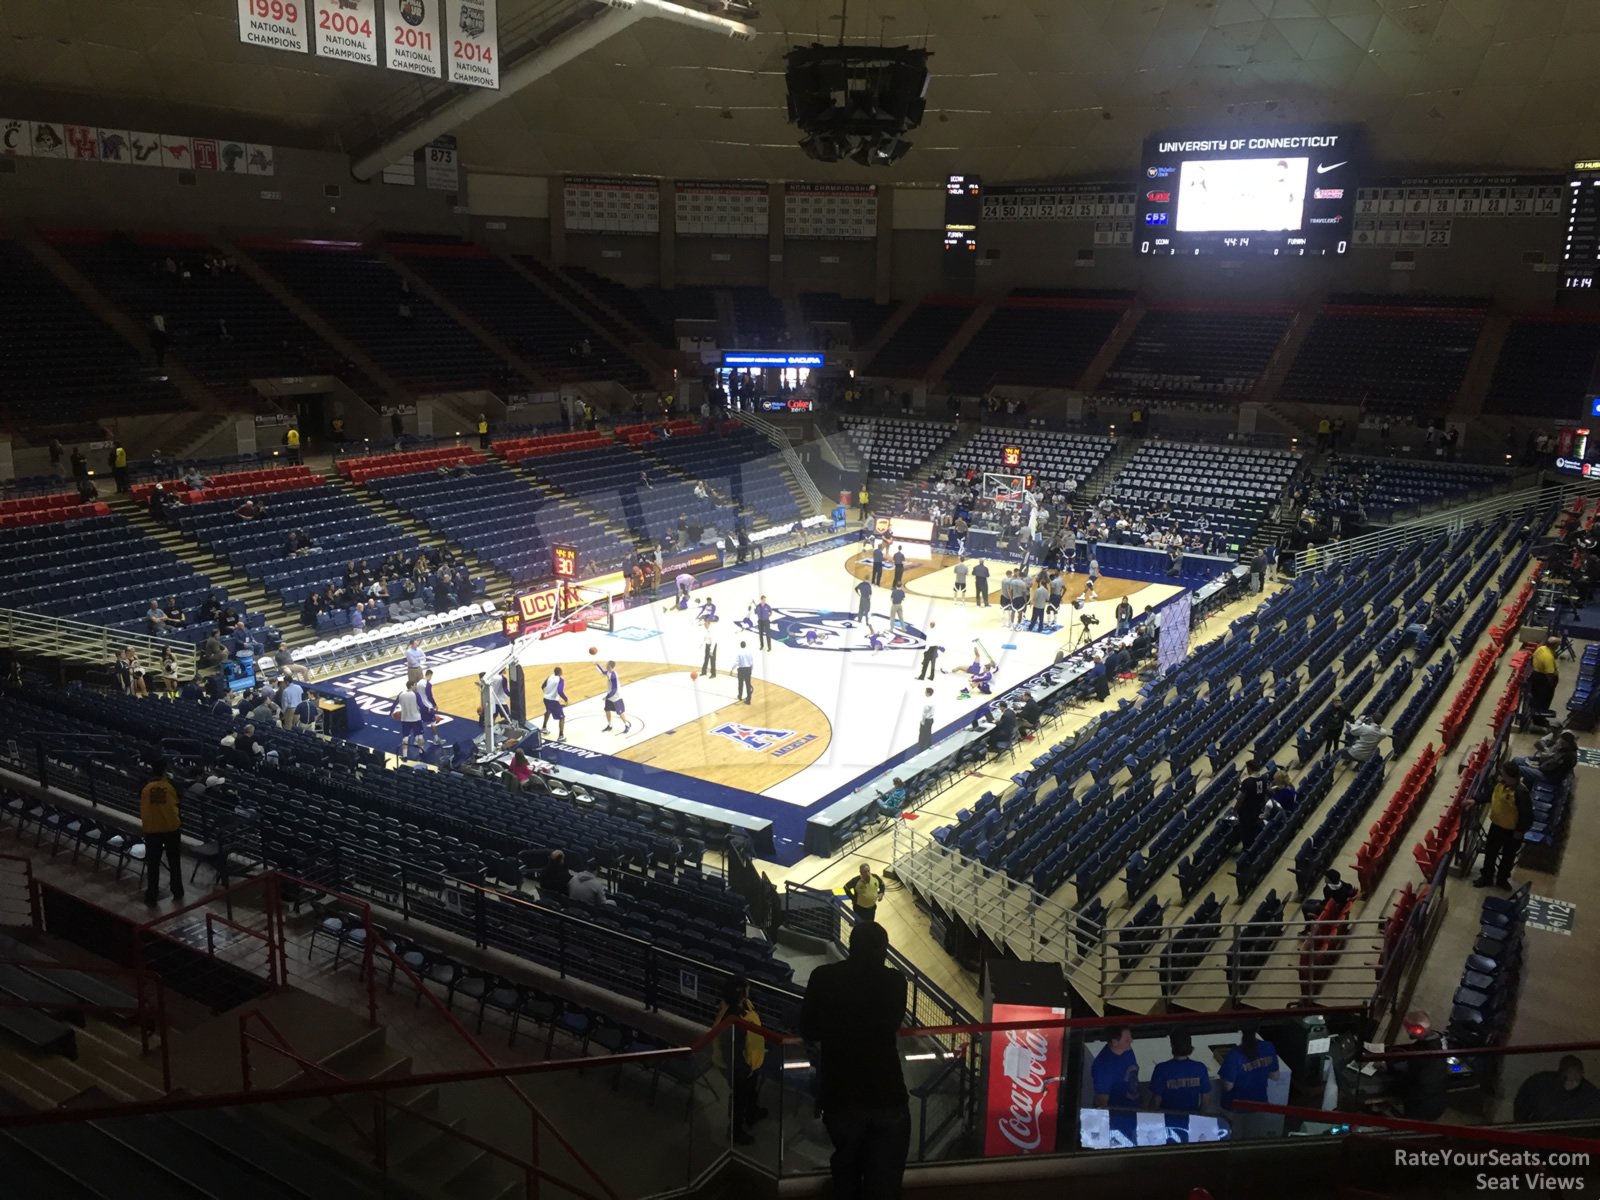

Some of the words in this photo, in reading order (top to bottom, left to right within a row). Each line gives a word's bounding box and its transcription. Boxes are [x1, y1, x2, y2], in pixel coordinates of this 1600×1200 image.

[249, 0, 298, 23] 1999
[250, 20, 296, 36] NATIONAL
[319, 10, 372, 38] 2004
[247, 32, 301, 50] CHAMPIONS
[325, 34, 368, 50] NATIONAL
[394, 26, 432, 50] 2011
[322, 46, 372, 62] CHAMPIONS
[395, 48, 432, 63] NATIONAL
[454, 40, 492, 64] 2014
[392, 59, 436, 75] CHAMPIONS
[456, 62, 492, 76] NATIONAL
[454, 72, 494, 86] CHAMPIONS
[1160, 140, 1227, 152] UNIVERSITY
[1230, 140, 1246, 150] OF
[1248, 136, 1338, 149] CONNECTICUT
[431, 150, 452, 163] 873
[985, 206, 997, 216] 24
[1002, 206, 1016, 216] 50
[1023, 206, 1034, 216] 21
[1041, 206, 1053, 216] 52
[1146, 213, 1166, 221] CBS
[1224, 238, 1250, 246] 44:14
[1430, 232, 1446, 242] 23
[1141, 242, 1150, 252] 0
[1337, 241, 1346, 253] 0
[1566, 278, 1592, 288] 11:14
[1006, 454, 1018, 464] 30
[557, 558, 573, 574] 30
